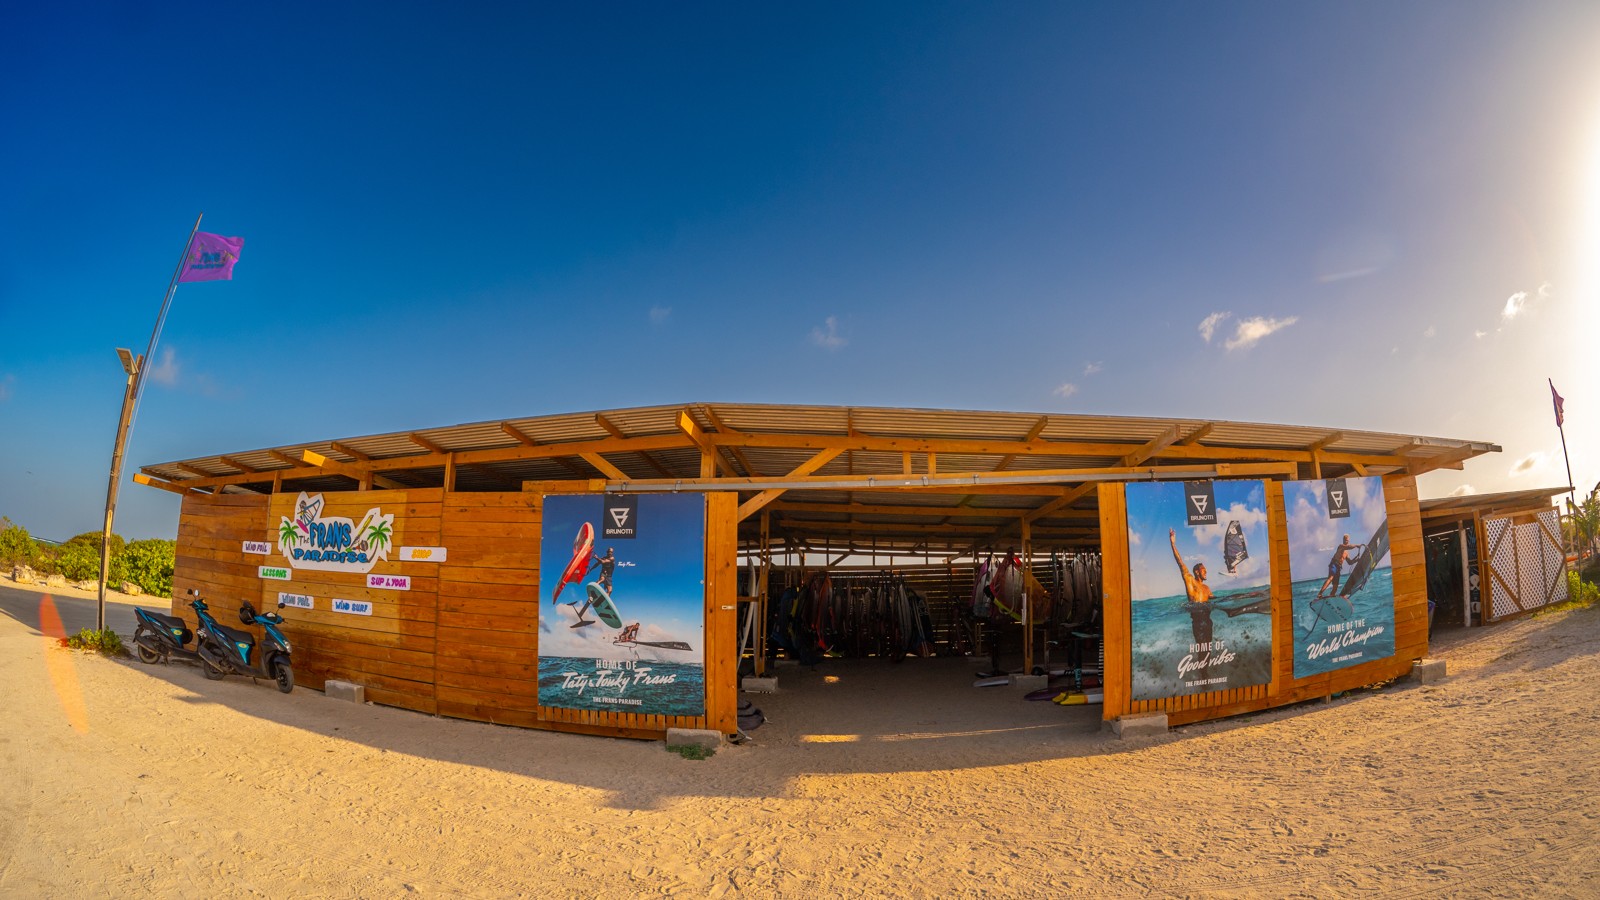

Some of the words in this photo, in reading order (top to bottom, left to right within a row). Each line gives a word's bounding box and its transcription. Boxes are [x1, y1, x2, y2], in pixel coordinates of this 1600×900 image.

[310, 521, 353, 552] FRANS
[262, 567, 287, 578] LESSONS
[371, 577, 385, 586] SUP
[391, 579, 407, 588] YOGA
[351, 603, 368, 613] SURF
[1327, 622, 1345, 634] HOME
[1346, 621, 1353, 630] OF
[1355, 618, 1366, 629] THE
[1189, 642, 1213, 653] HOME
[1215, 640, 1225, 651] OF
[1306, 634, 1343, 660] World
[1342, 625, 1384, 645] Champion
[596, 659, 622, 670] HOME
[626, 660, 637, 670] OF
[1177, 652, 1211, 679] Good
[1208, 648, 1236, 667] vibes
[562, 672, 588, 695] Taty
[595, 670, 631, 693] Tonky
[633, 667, 677, 685] Frans
[1207, 677, 1228, 685] PARADISE
[618, 698, 643, 706] PARADISE
